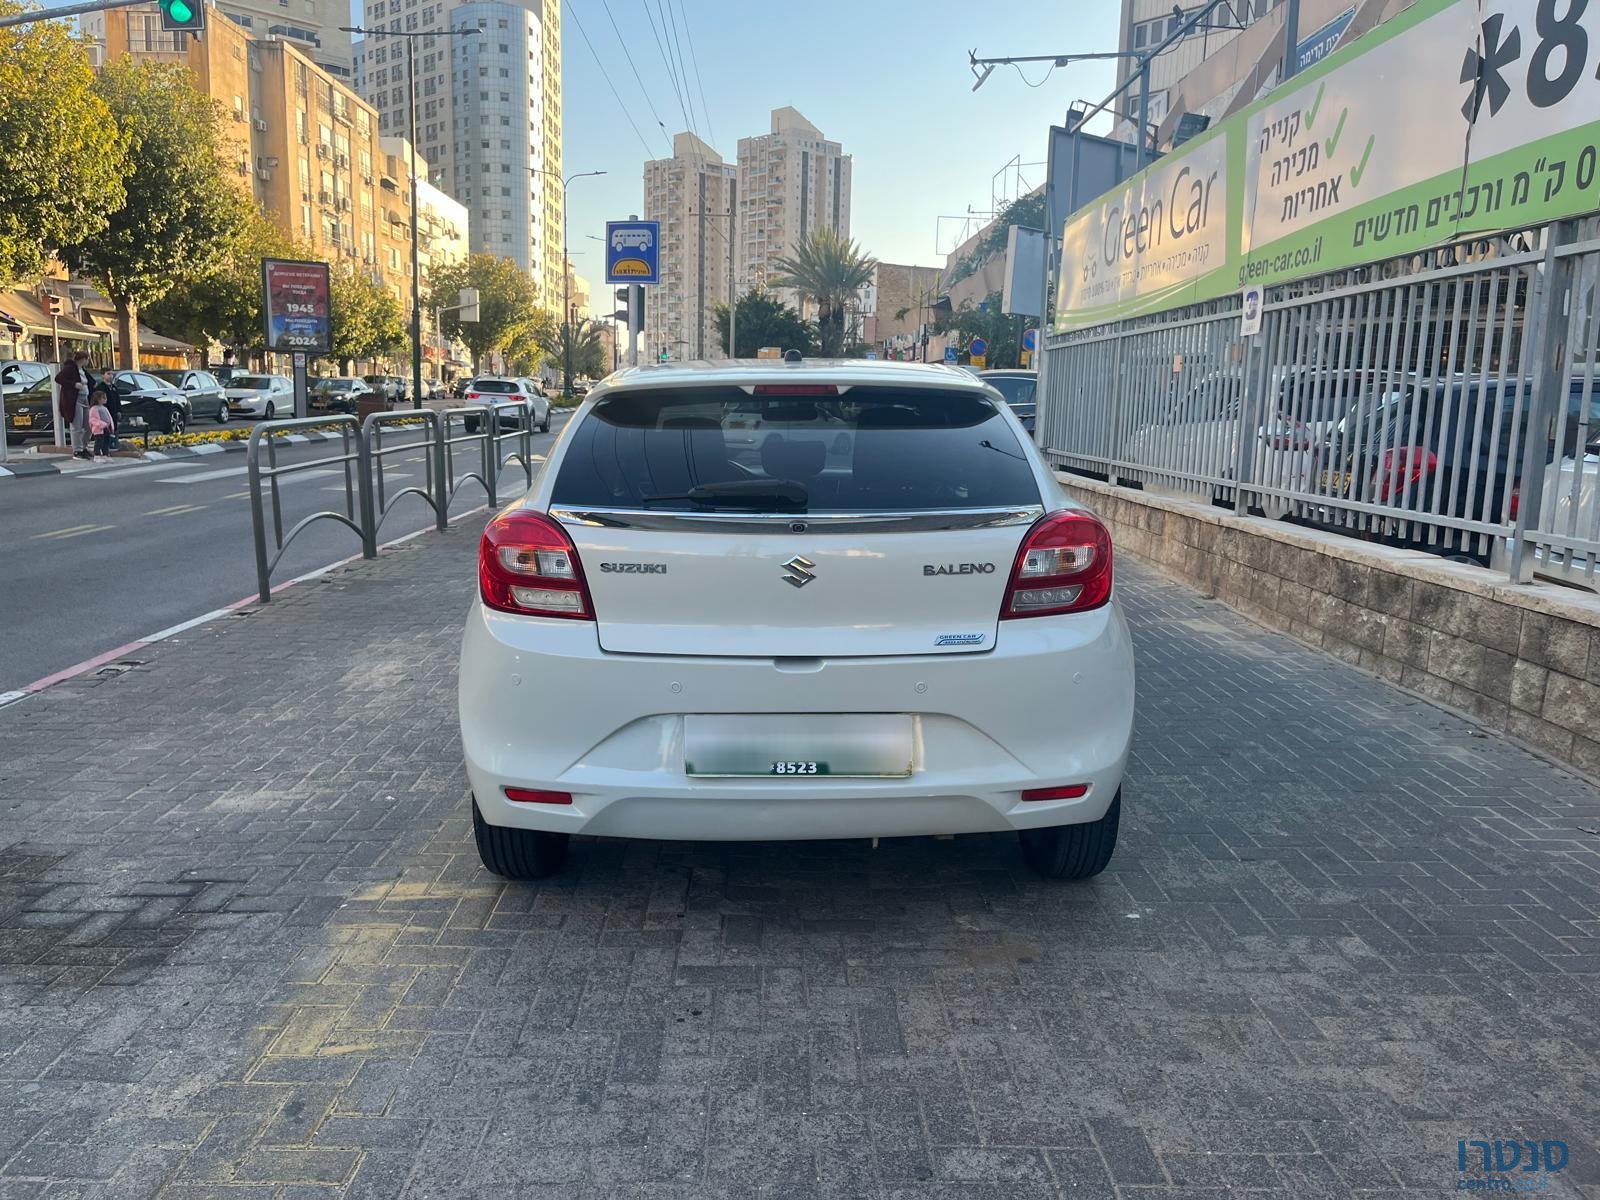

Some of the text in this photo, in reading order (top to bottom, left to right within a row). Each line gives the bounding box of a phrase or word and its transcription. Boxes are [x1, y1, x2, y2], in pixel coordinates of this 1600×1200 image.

[1300, 42, 1324, 67] קדימה
[1260, 110, 1301, 154] קנייה
[1271, 141, 1319, 188] מכירה
[1104, 166, 1218, 267] Green Car
[1281, 174, 1343, 223] אחריות
[1425, 178, 1503, 228] ורכבים
[1353, 204, 1419, 247] חדשים
[1238, 235, 1323, 286] green-car.co.il
[286, 303, 314, 313] 1945
[288, 336, 318, 346] 2024
[600, 562, 667, 574] SUZUKI
[923, 562, 995, 576] BALENO
